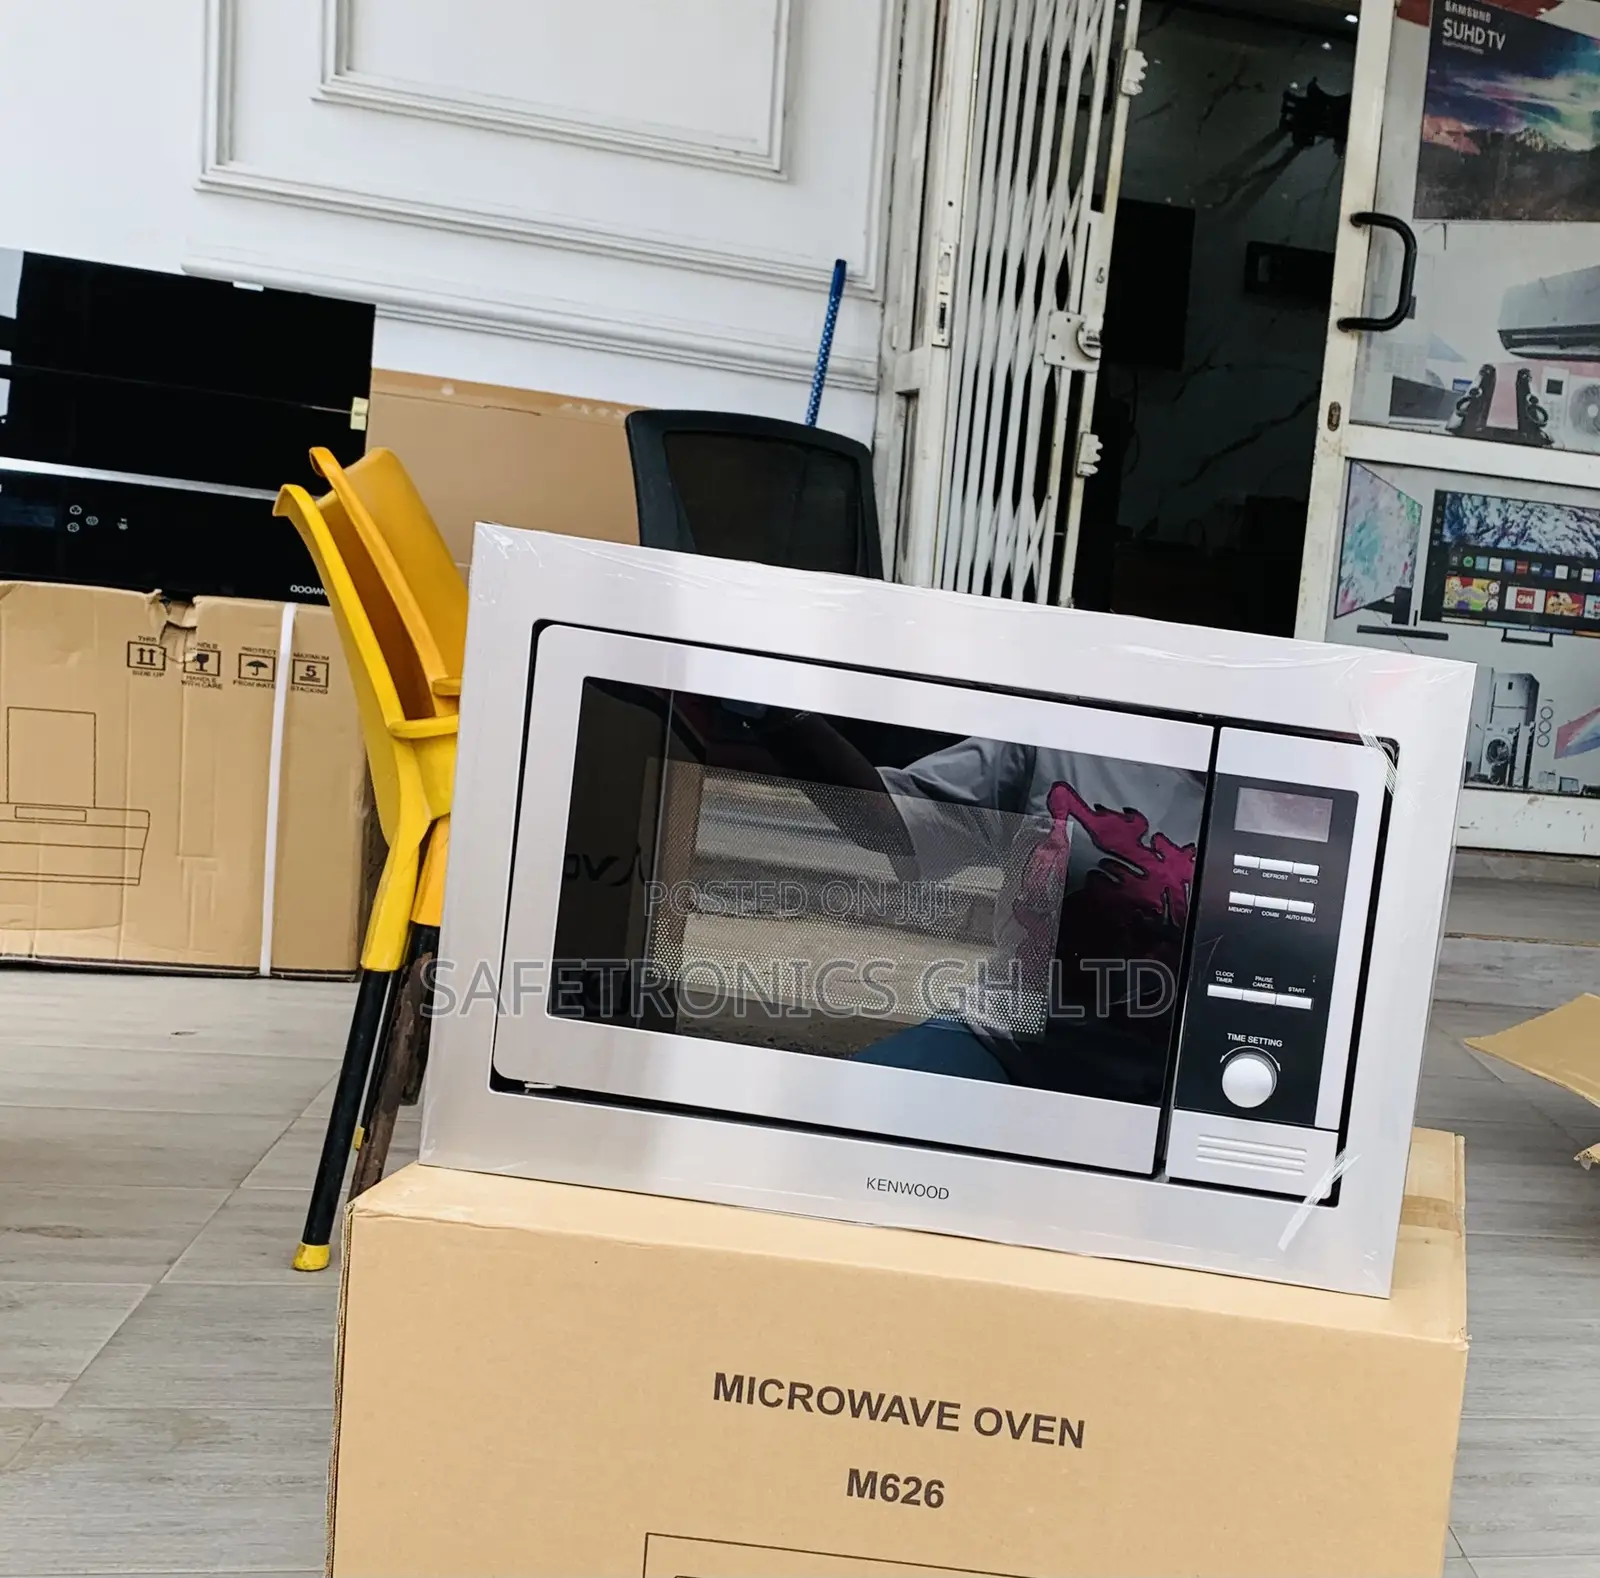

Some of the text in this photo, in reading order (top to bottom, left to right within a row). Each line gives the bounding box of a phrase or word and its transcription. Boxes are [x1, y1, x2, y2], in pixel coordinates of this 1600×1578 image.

[1445, 0, 1491, 23] SAMSUNG
[1517, 594, 1534, 605] CNN
[241, 646, 277, 656] PROTECT
[293, 652, 329, 661] MAXIMUM
[305, 665, 317, 678] 5
[201, 682, 223, 690] CARE
[255, 681, 275, 689] WATE
[290, 685, 329, 695] STACKING
[1232, 868, 1249, 876] GRILL
[1262, 872, 1289, 881] DEFROST
[1299, 877, 1318, 885] MICRO
[1228, 906, 1253, 914] MEMORY
[1261, 910, 1280, 918] COMBI
[1300, 915, 1316, 923] MENU
[1215, 970, 1235, 978] CLOCK
[1216, 976, 1233, 984] TIMER
[1254, 975, 1273, 983] PAUSE
[1252, 981, 1275, 990] CANCEL
[1288, 986, 1306, 994] START
[1227, 1032, 1283, 1047] TIME SETTING
[866, 1177, 950, 1200] KENWOOD
[713, 1371, 1085, 1449] MICROWAVE OVEN
[846, 1468, 945, 1509] M626
